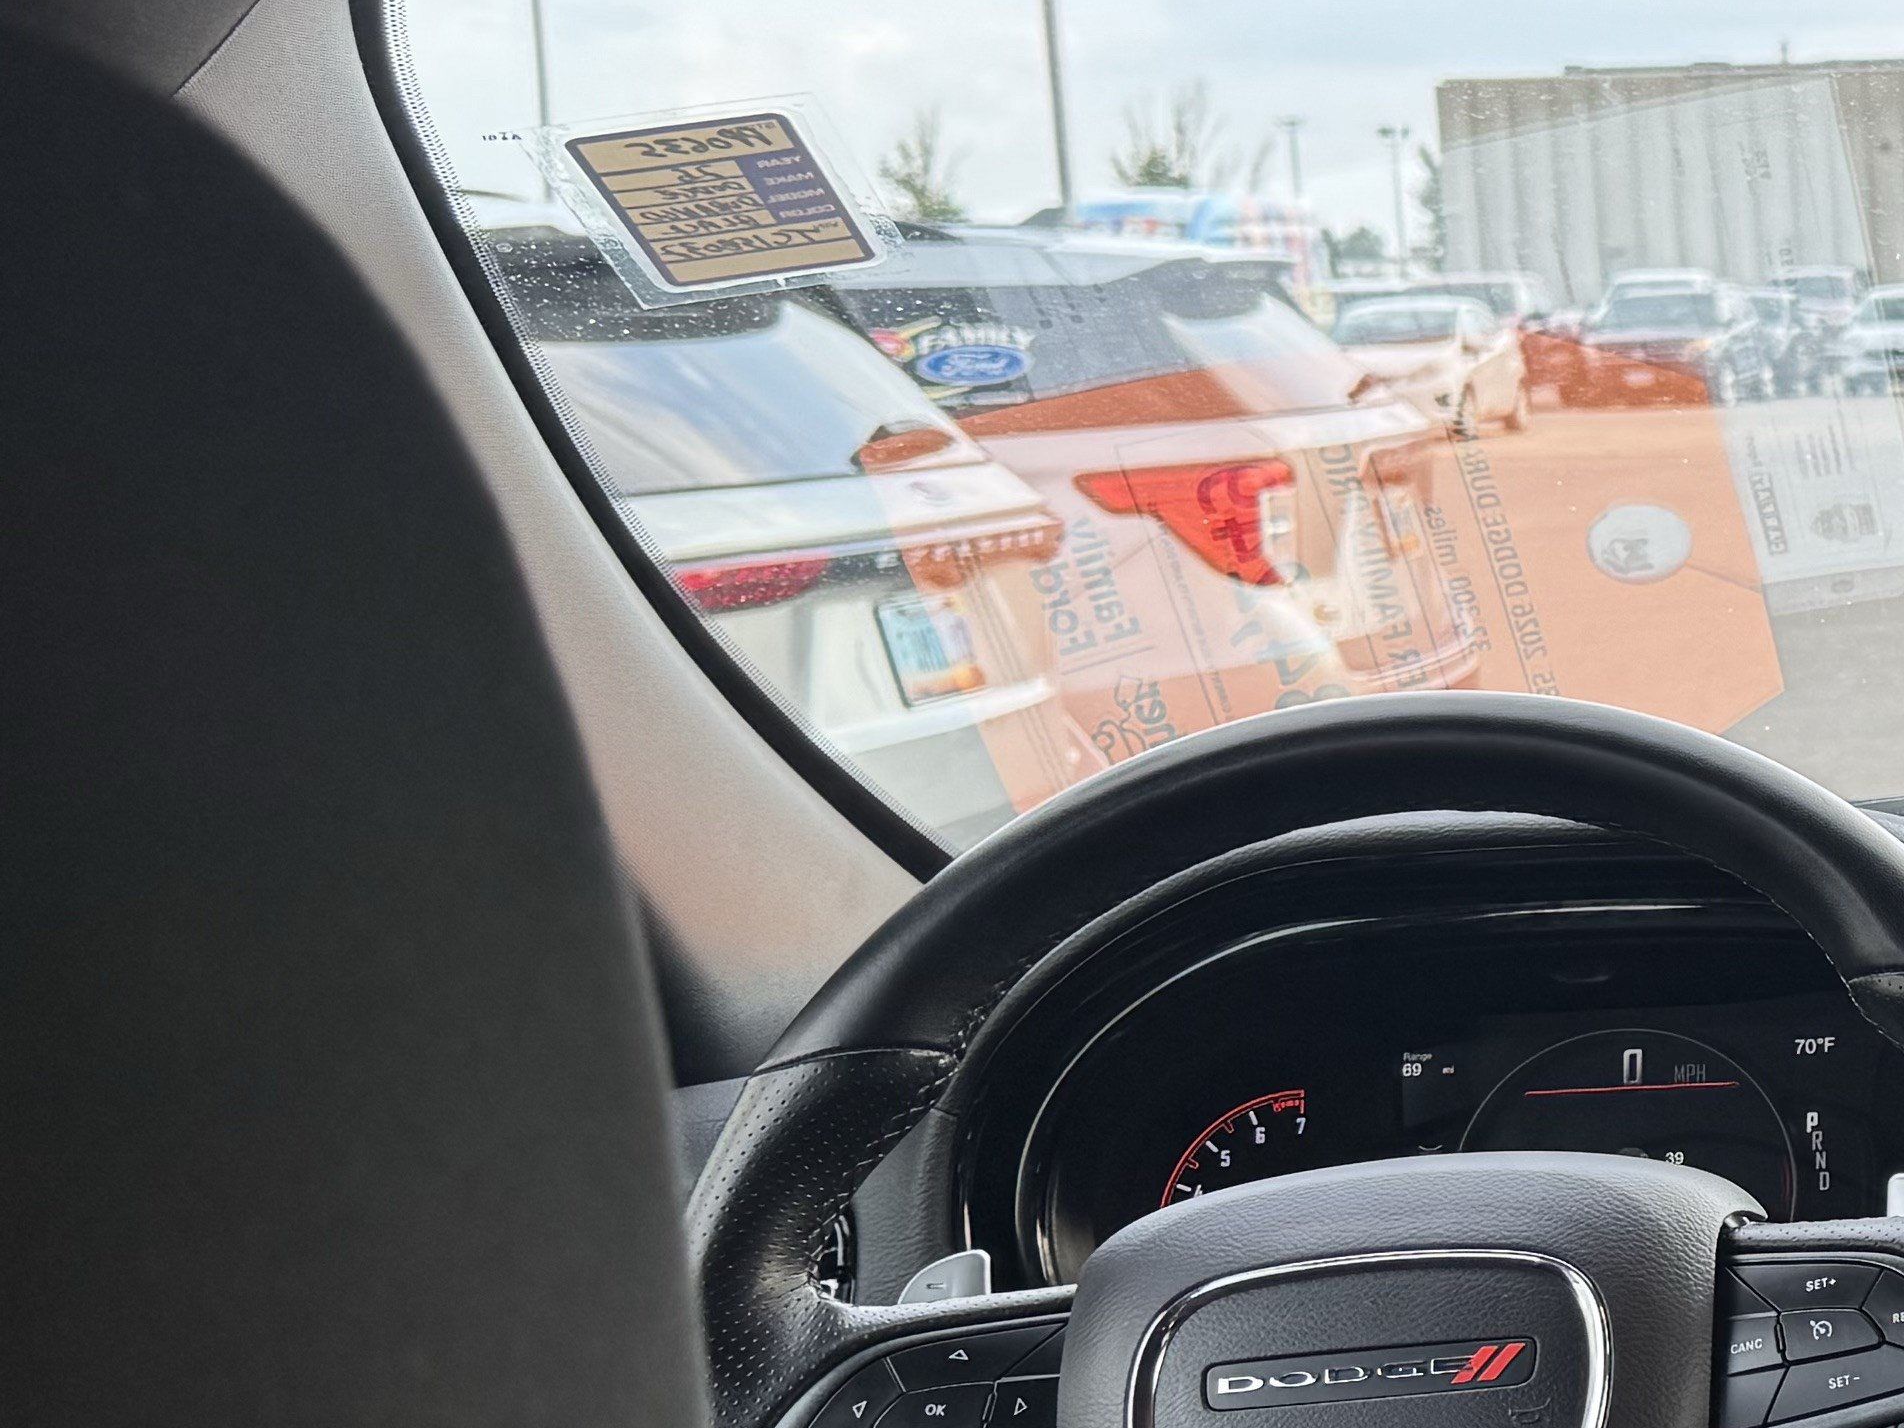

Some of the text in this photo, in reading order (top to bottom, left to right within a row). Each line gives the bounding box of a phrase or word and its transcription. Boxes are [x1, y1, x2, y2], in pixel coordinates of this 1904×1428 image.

[1794, 1036, 1836, 1055] 70°F
[1402, 1062, 1422, 1077] 69
[1623, 1048, 1706, 1085] 0 MPH
[1296, 1117, 1306, 1135] 7
[1806, 1111, 1819, 1133] P
[1255, 1126, 1266, 1144] 6
[1811, 1130, 1823, 1151] R
[1220, 1149, 1231, 1167] 5
[1665, 1152, 1685, 1165] 39
[1815, 1151, 1827, 1170] N
[1819, 1171, 1830, 1191] D
[1730, 1338, 1763, 1355] CANC
[1216, 1355, 1476, 1395] DODGE
[924, 1402, 946, 1417] OK
